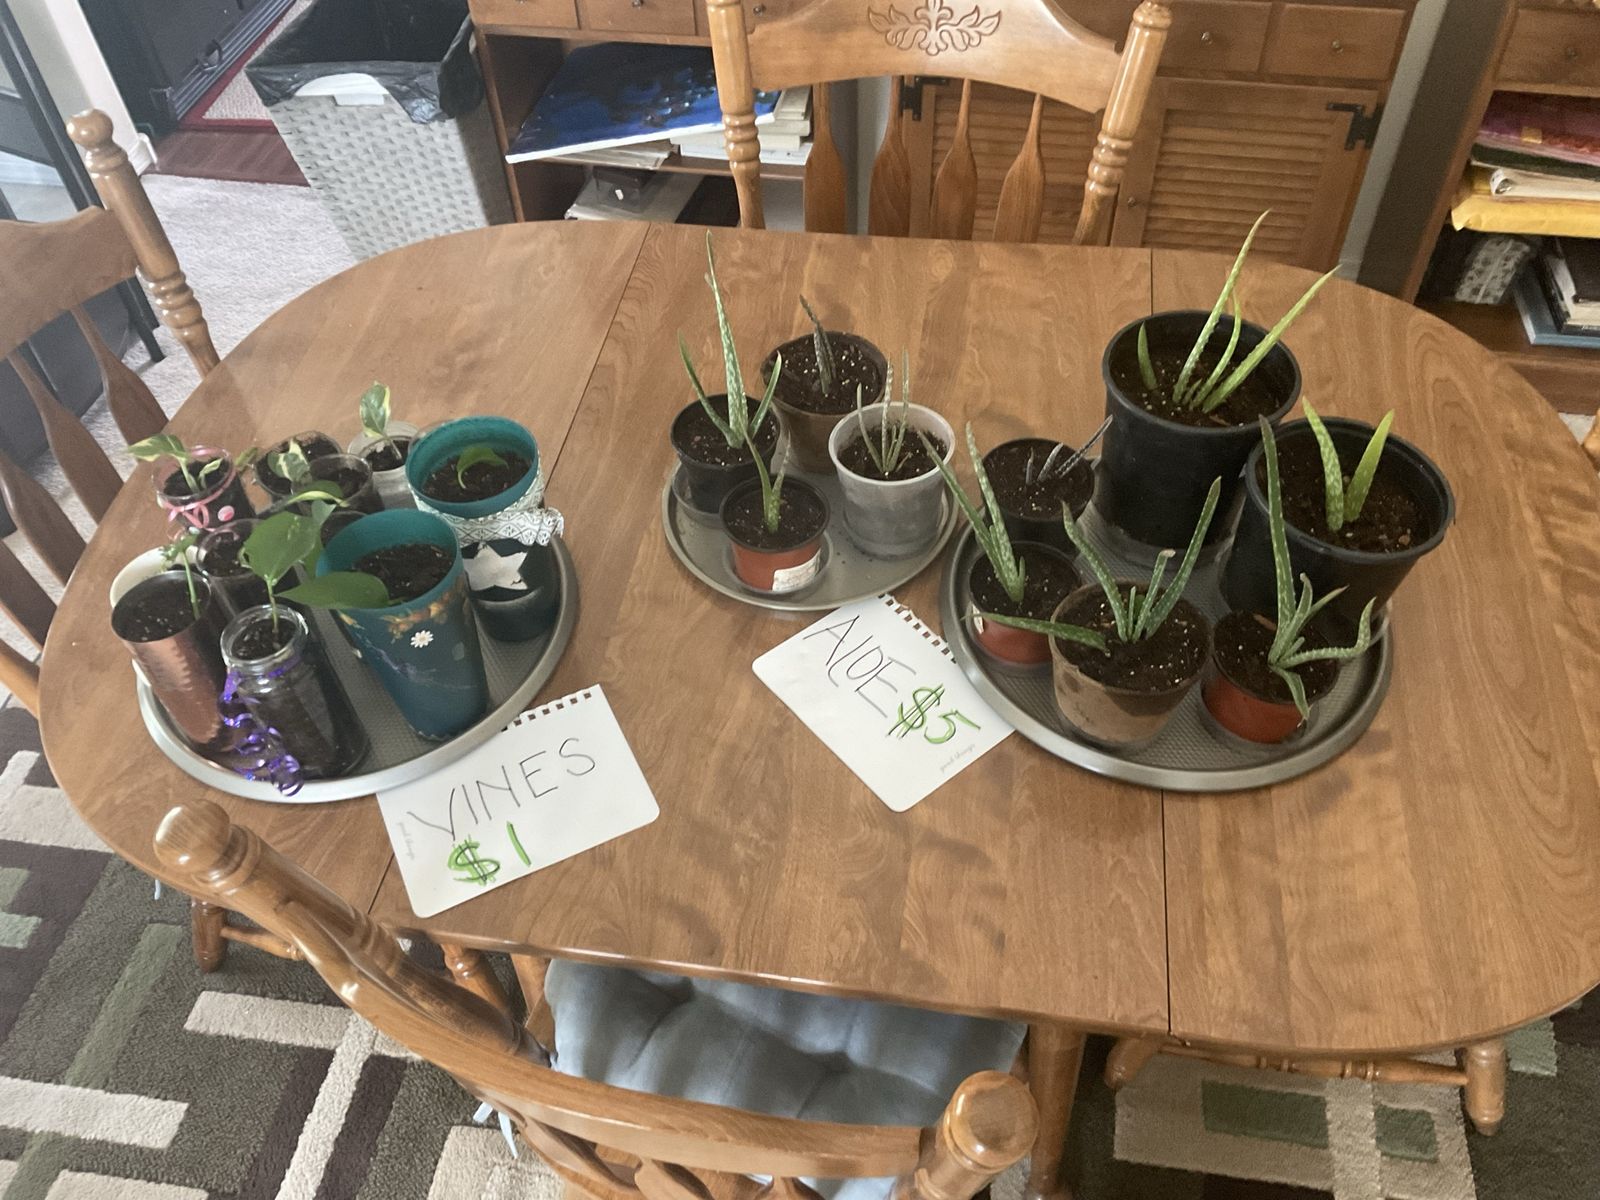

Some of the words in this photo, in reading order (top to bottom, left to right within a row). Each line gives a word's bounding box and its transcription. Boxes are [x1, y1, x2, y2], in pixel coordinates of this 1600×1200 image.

[803, 615, 917, 718] ALOE
[886, 683, 981, 744] $5
[407, 738, 596, 841] VINES
[448, 820, 532, 886] $1
